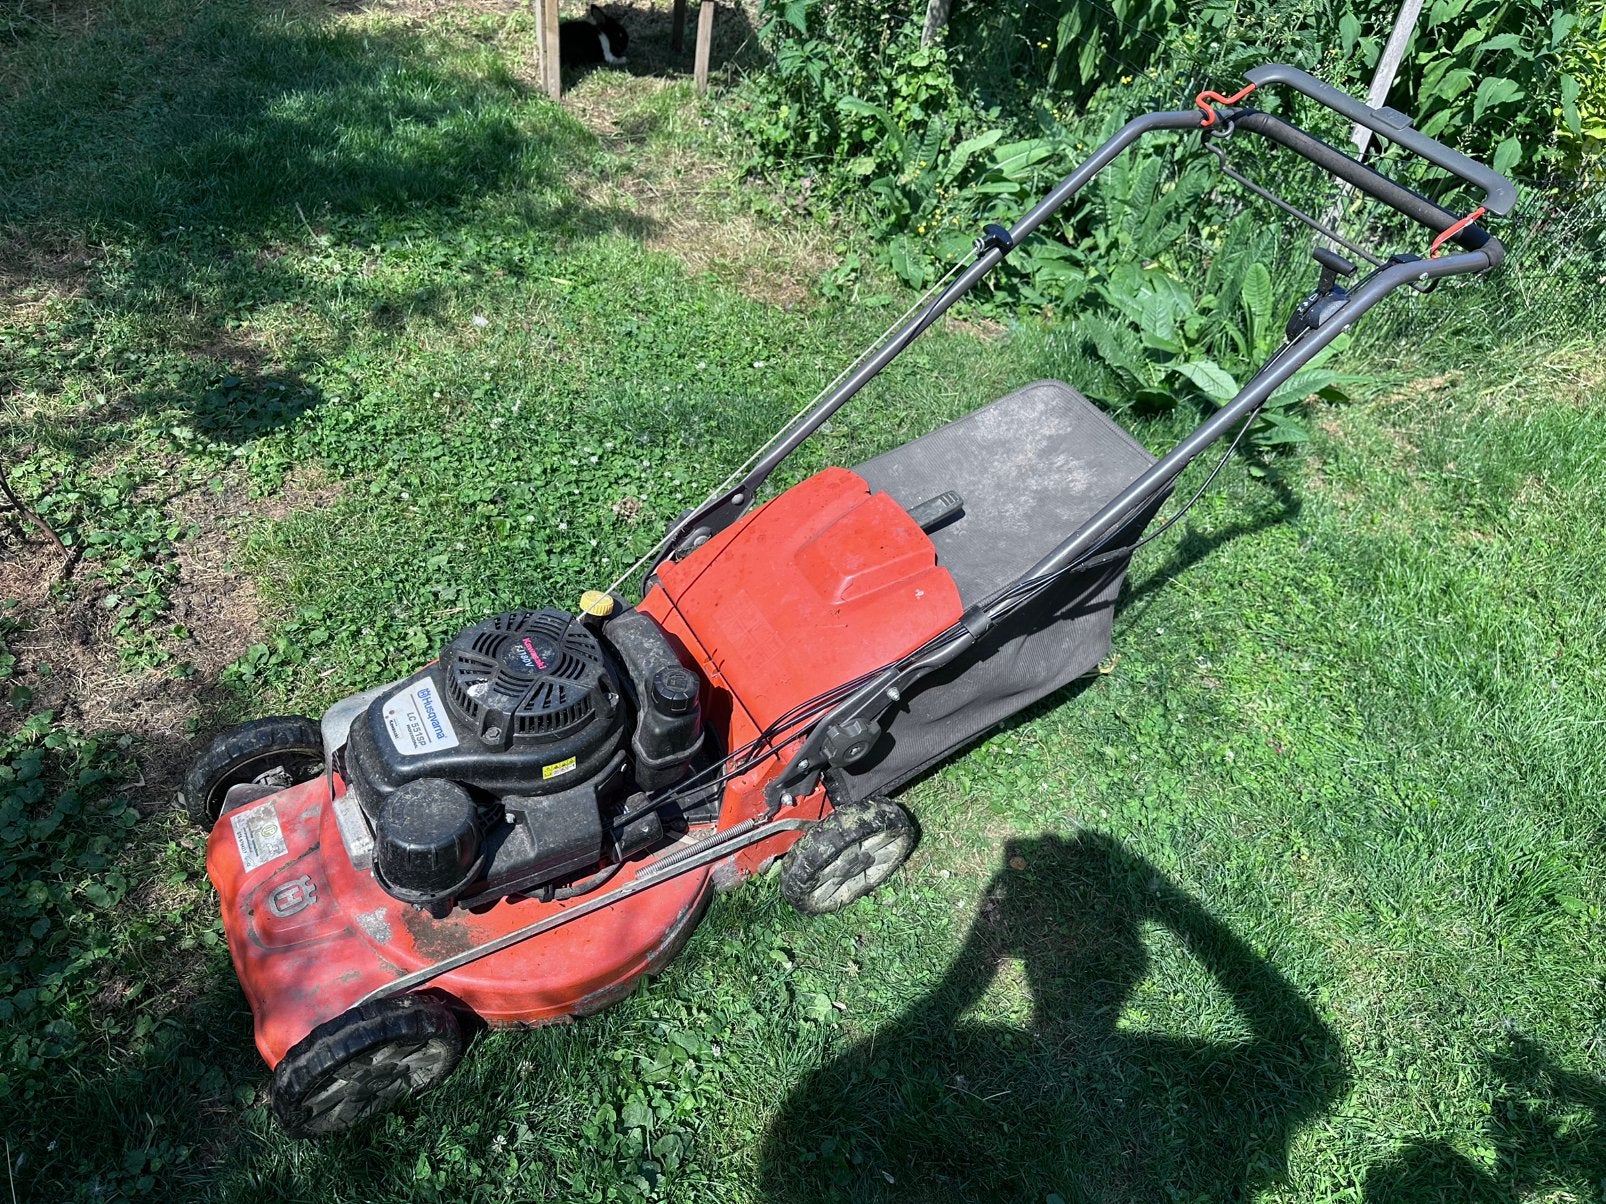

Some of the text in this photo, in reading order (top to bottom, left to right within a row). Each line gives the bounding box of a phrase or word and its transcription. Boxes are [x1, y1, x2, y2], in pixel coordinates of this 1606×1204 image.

[522, 638, 547, 669] Kawasaki
[407, 712, 416, 721] LC
[422, 697, 445, 740] Husqvarna
